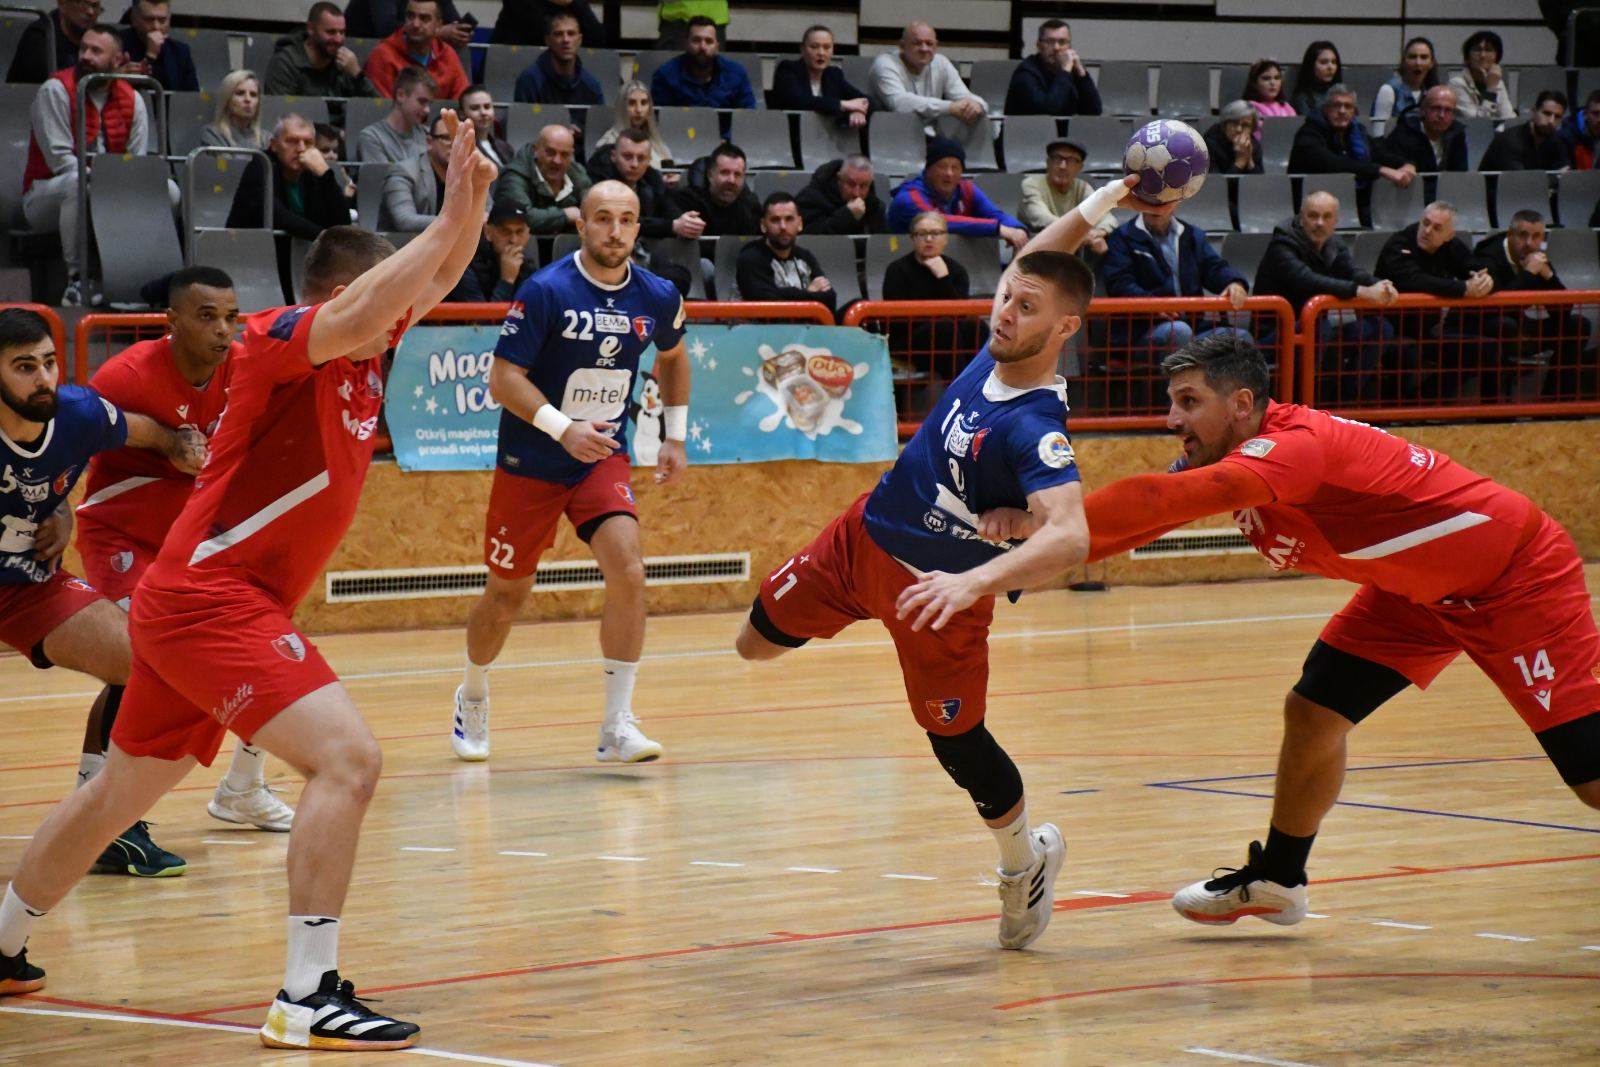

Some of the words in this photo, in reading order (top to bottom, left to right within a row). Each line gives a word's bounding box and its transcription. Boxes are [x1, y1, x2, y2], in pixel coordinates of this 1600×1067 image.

[561, 309, 594, 341] 22
[572, 384, 625, 403] m:tel
[459, 443, 480, 456] svoj
[490, 537, 515, 570] 22
[1513, 649, 1555, 687] 14
